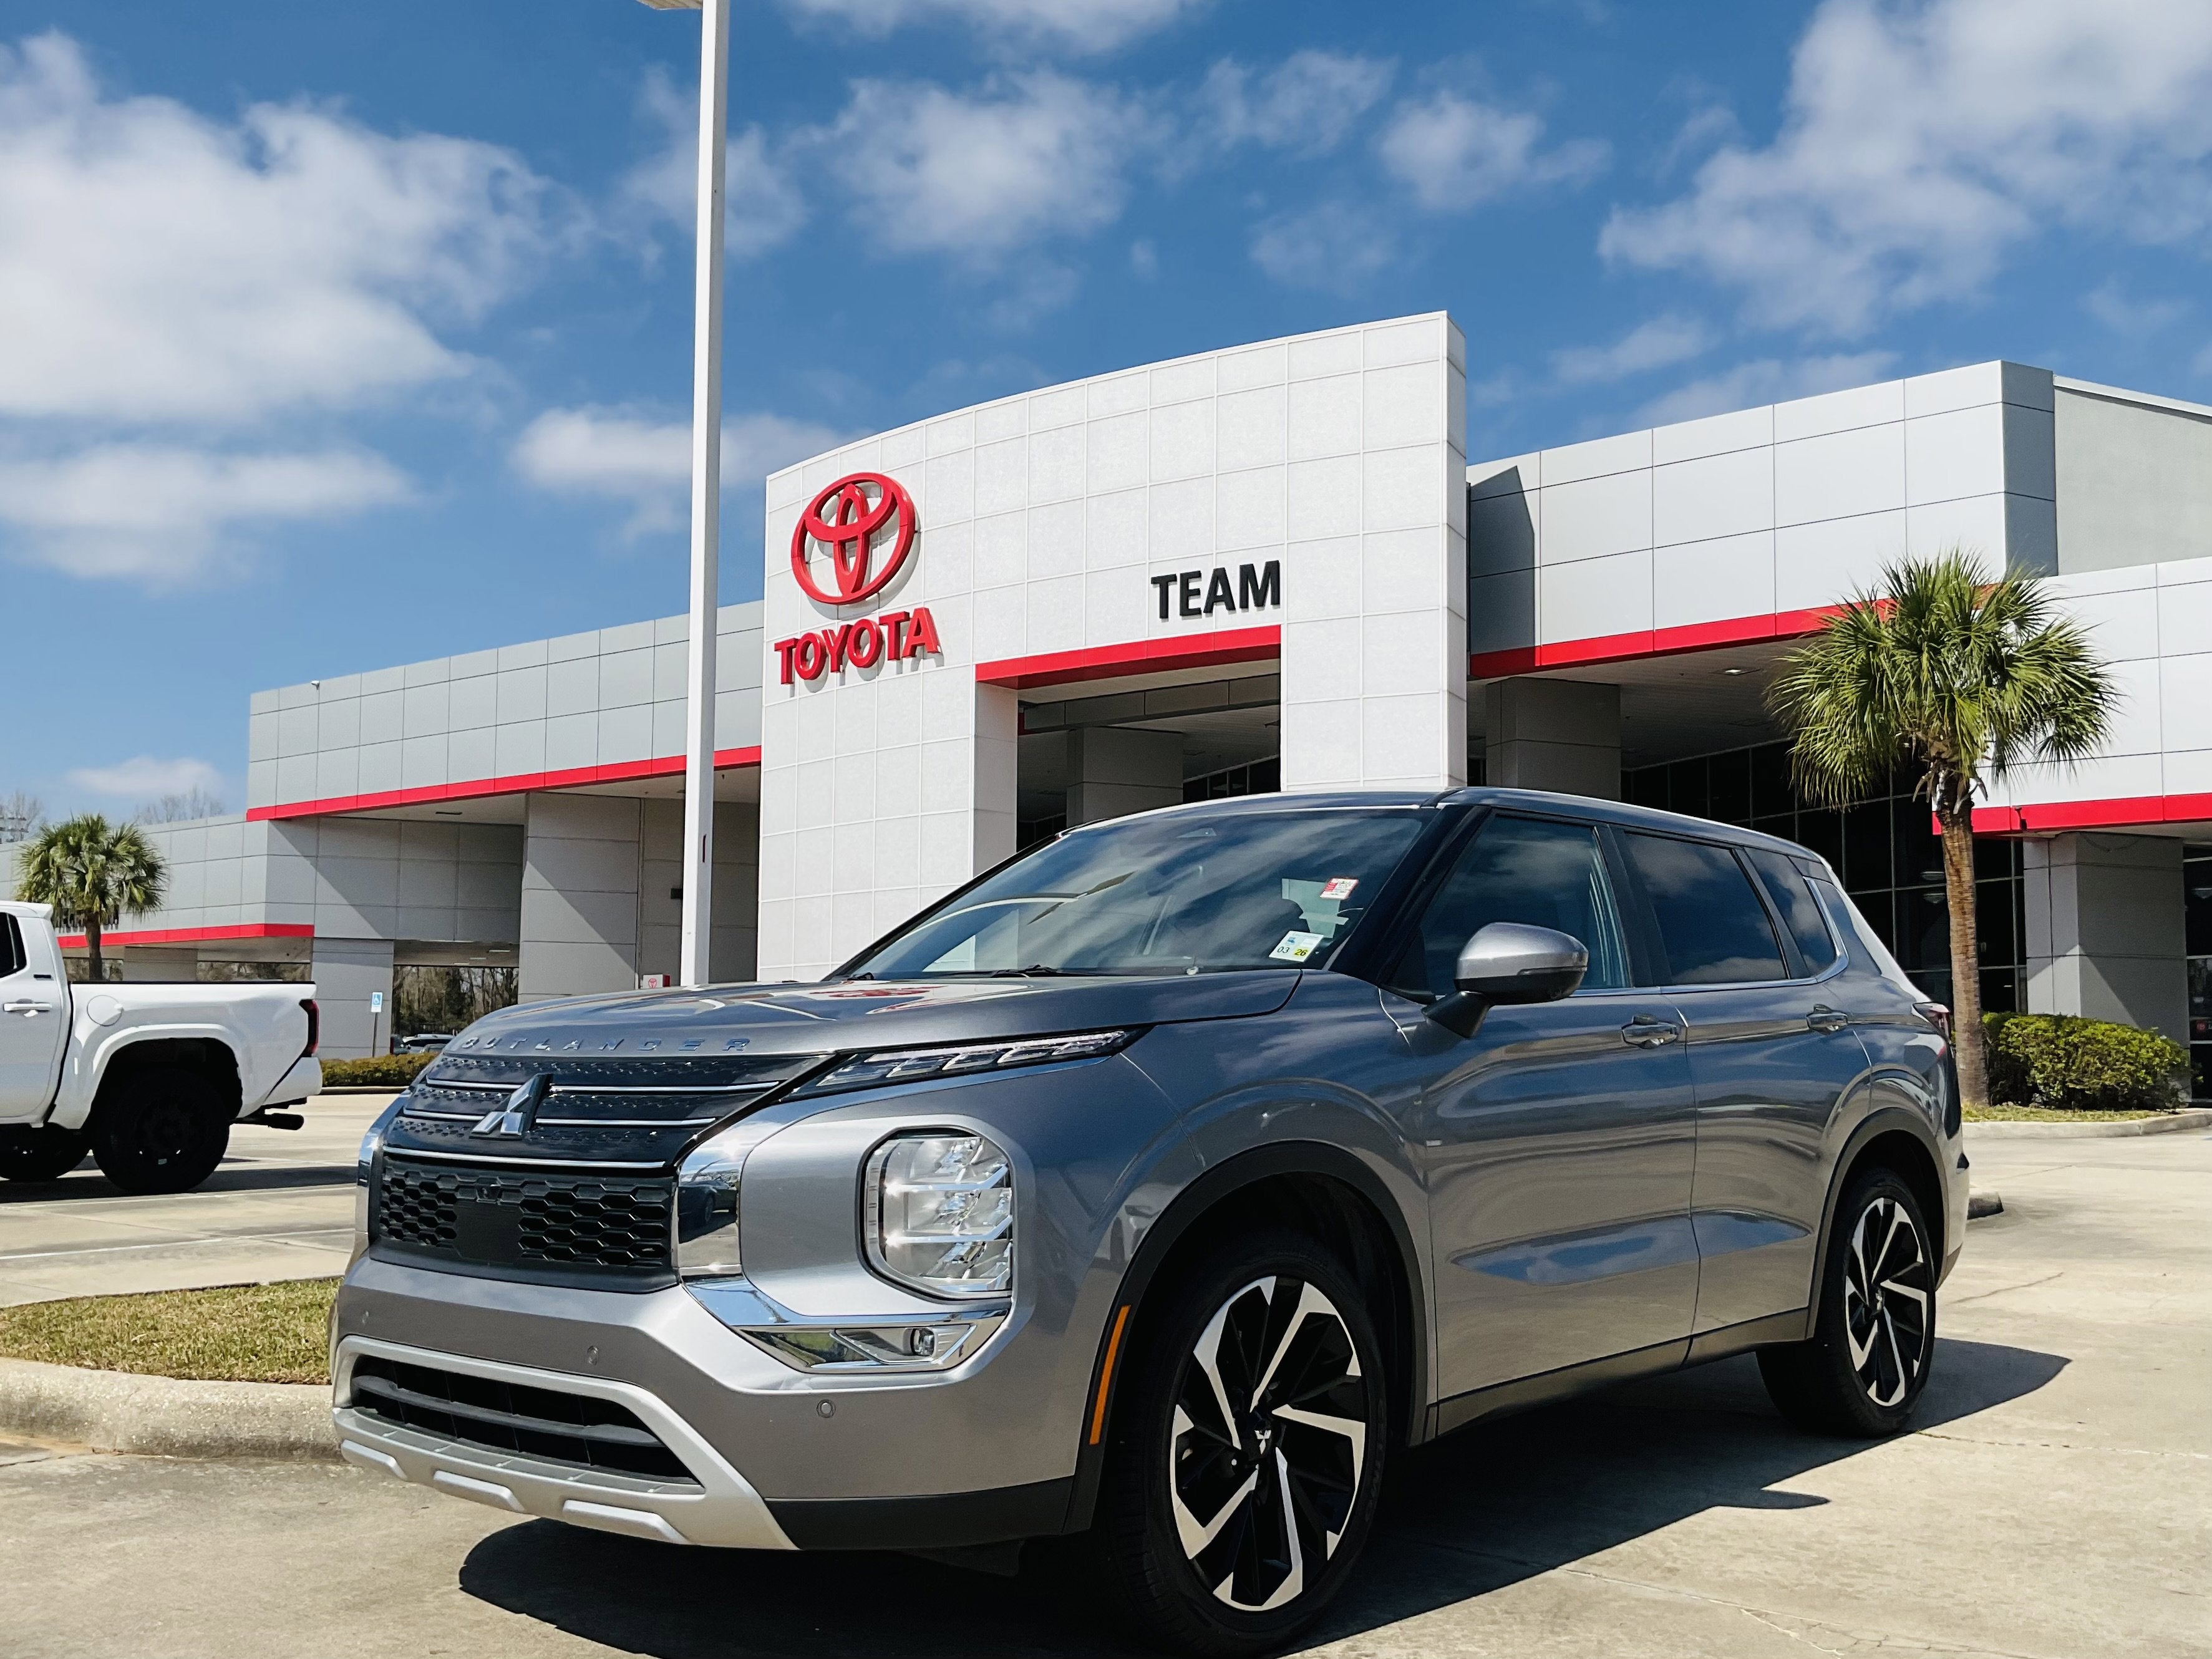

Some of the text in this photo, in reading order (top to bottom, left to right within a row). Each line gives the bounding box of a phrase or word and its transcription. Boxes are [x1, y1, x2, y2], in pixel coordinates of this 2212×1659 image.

[1151, 560, 1280, 619] TEAM
[775, 607, 941, 685] TOYOTA
[462, 1037, 750, 1052] OUTLANDER
